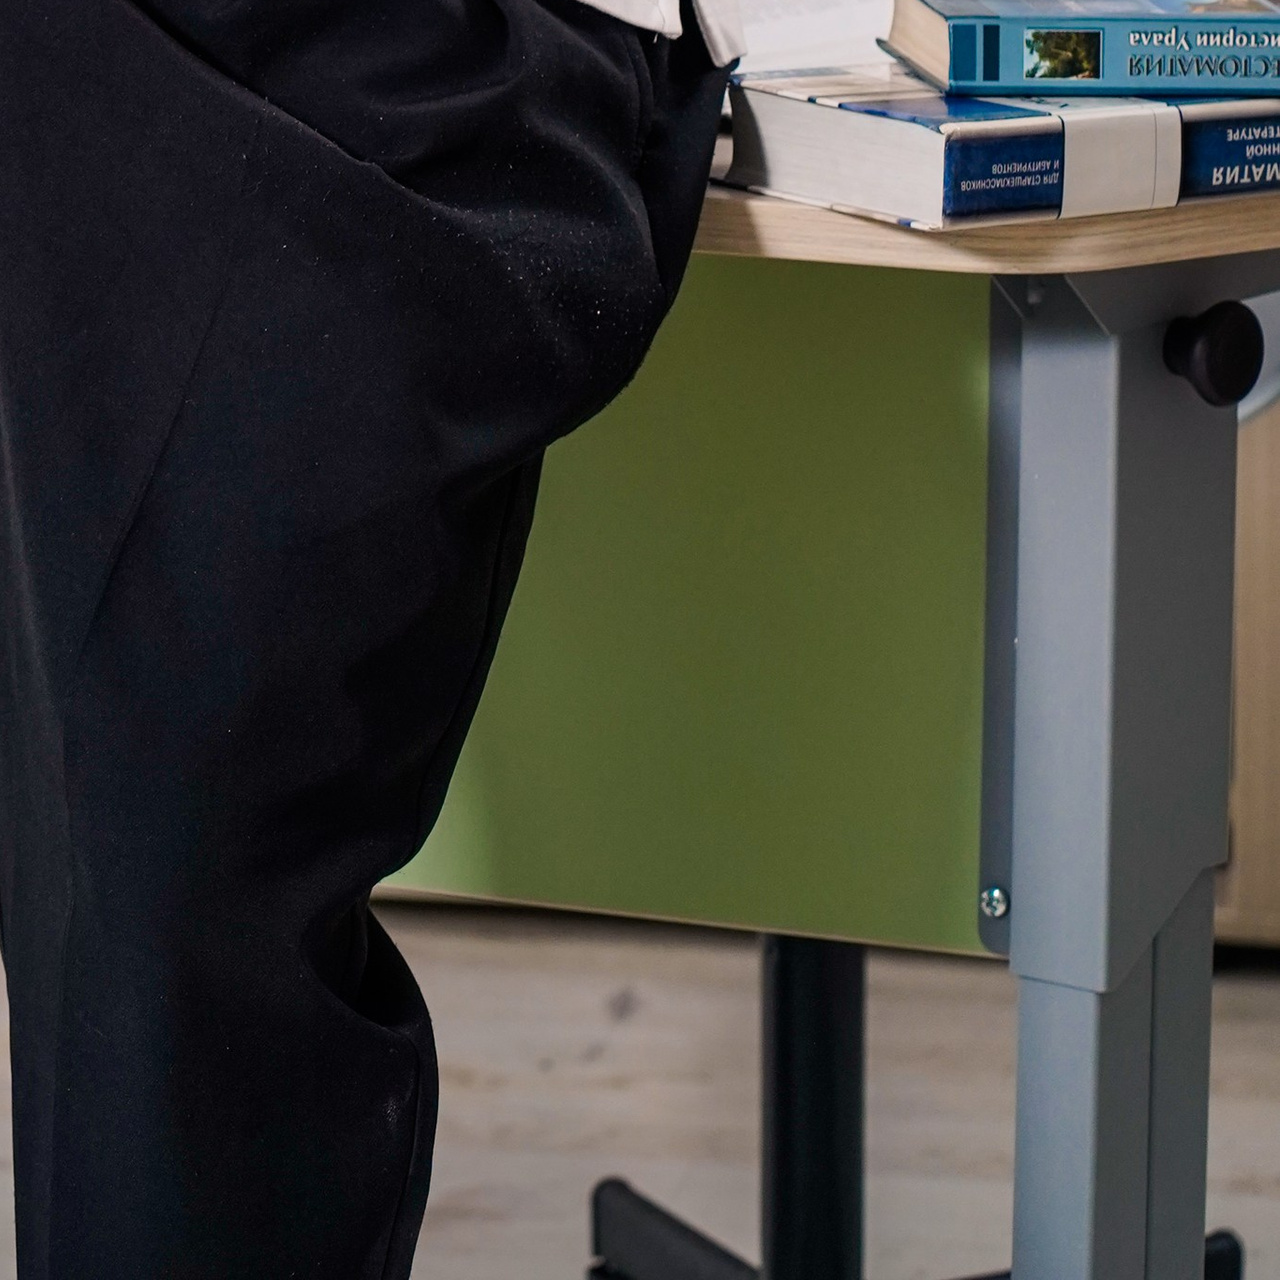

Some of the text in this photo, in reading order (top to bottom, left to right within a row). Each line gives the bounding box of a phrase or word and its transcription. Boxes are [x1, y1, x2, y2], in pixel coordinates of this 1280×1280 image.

[1129, 27, 1190, 51] Урала
[992, 160, 1060, 175] И АБИТУРИЕНТОВ
[960, 172, 1059, 191] ДЛЯ СТАРШЕКЛАССНИКОВ
